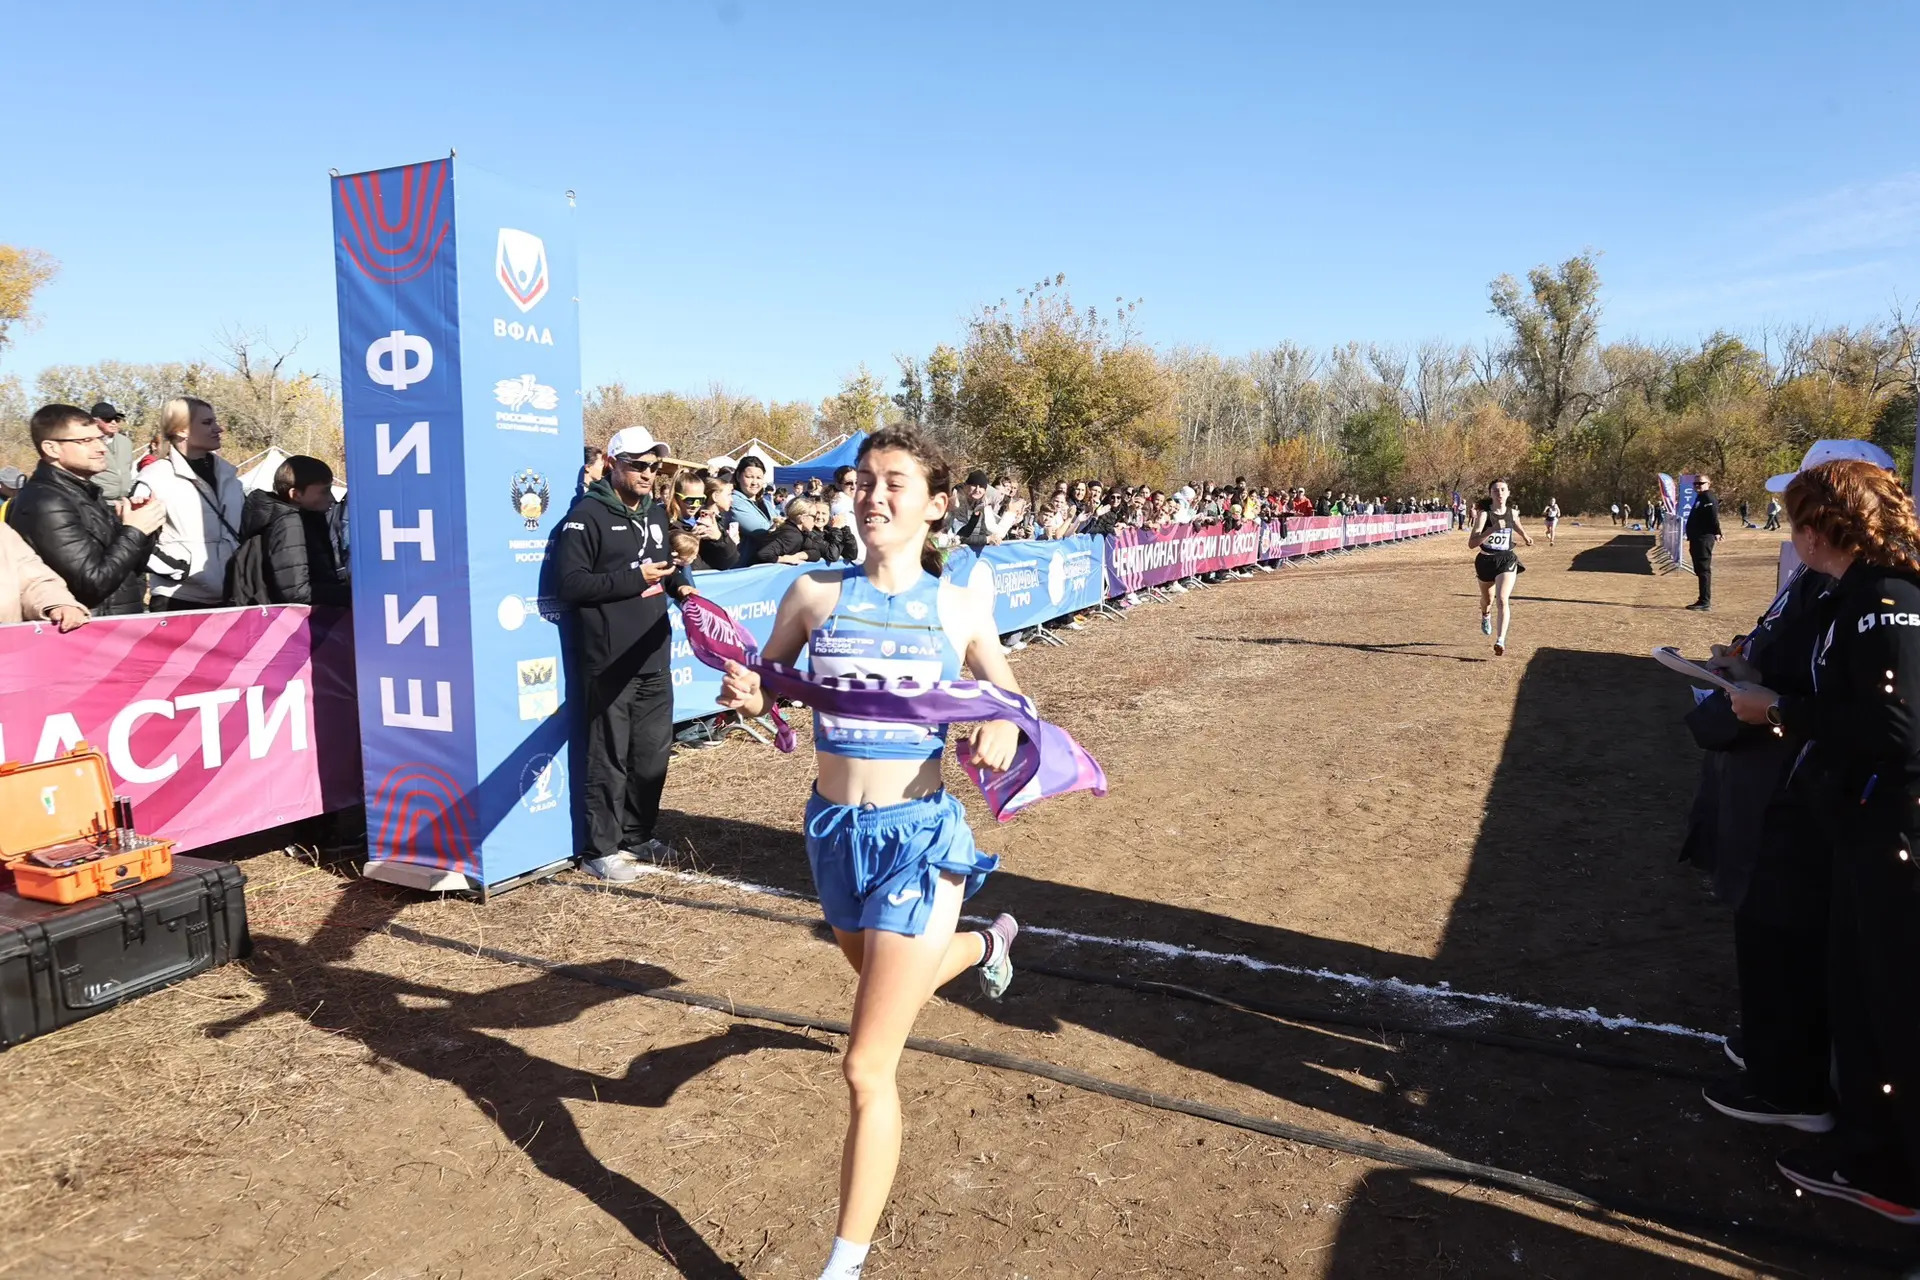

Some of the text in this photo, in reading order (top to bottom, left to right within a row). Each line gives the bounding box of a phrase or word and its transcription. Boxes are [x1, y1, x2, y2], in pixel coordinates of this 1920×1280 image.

[493, 318, 554, 346] ВФЛА
[365, 330, 453, 733] ФИНИШ
[1488, 535, 1507, 545] 207
[1113, 539, 1180, 577] ЧЕМПИОНАТ
[1181, 535, 1217, 563] РОССИИ
[1218, 534, 1231, 557] ПО
[1232, 532, 1257, 556] КРОССУ
[1881, 613, 1920, 626] ПСБ
[900, 645, 936, 655] ВФЛА
[0, 678, 308, 784] АСТИ
